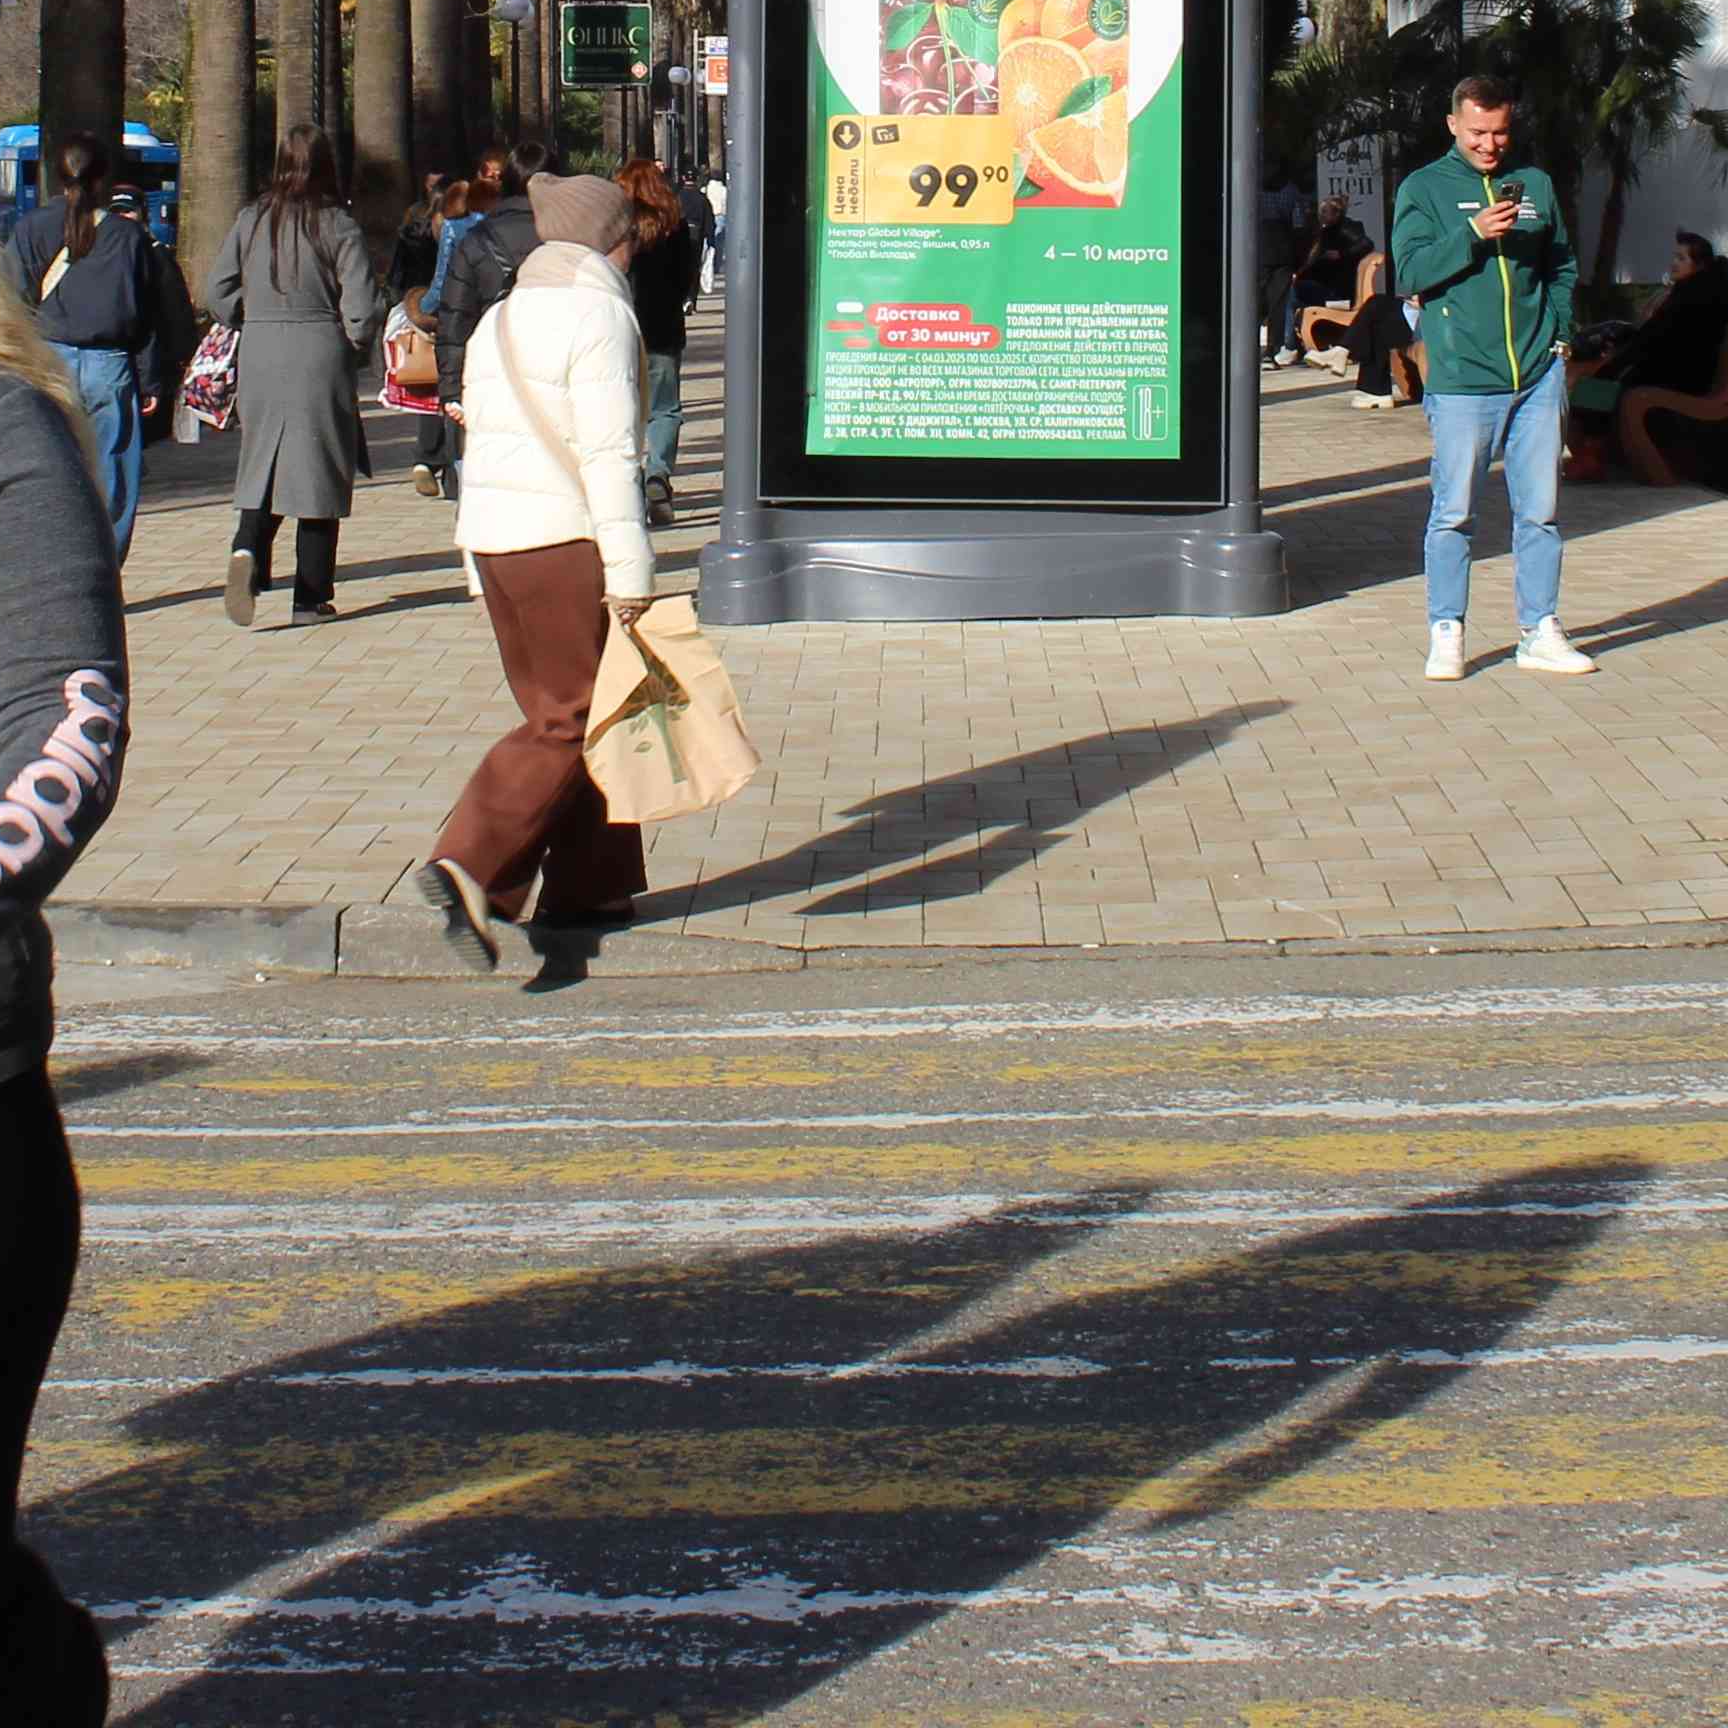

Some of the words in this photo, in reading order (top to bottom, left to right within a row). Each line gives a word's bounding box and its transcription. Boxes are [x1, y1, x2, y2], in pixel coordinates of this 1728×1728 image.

[983, 166, 1009, 183] 90
[833, 175, 845, 215] Цена
[847, 159, 859, 215] недели
[909, 164, 978, 207] 99
[827, 227, 866, 239] Нектар
[1044, 245, 1056, 261] 4
[1082, 245, 1102, 261] 10
[1107, 248, 1169, 264] марта
[875, 307, 960, 323] Доставка
[887, 329, 908, 342] от
[910, 328, 931, 342] 30
[934, 330, 991, 346] минут
[1139, 387, 1164, 439] 18+
